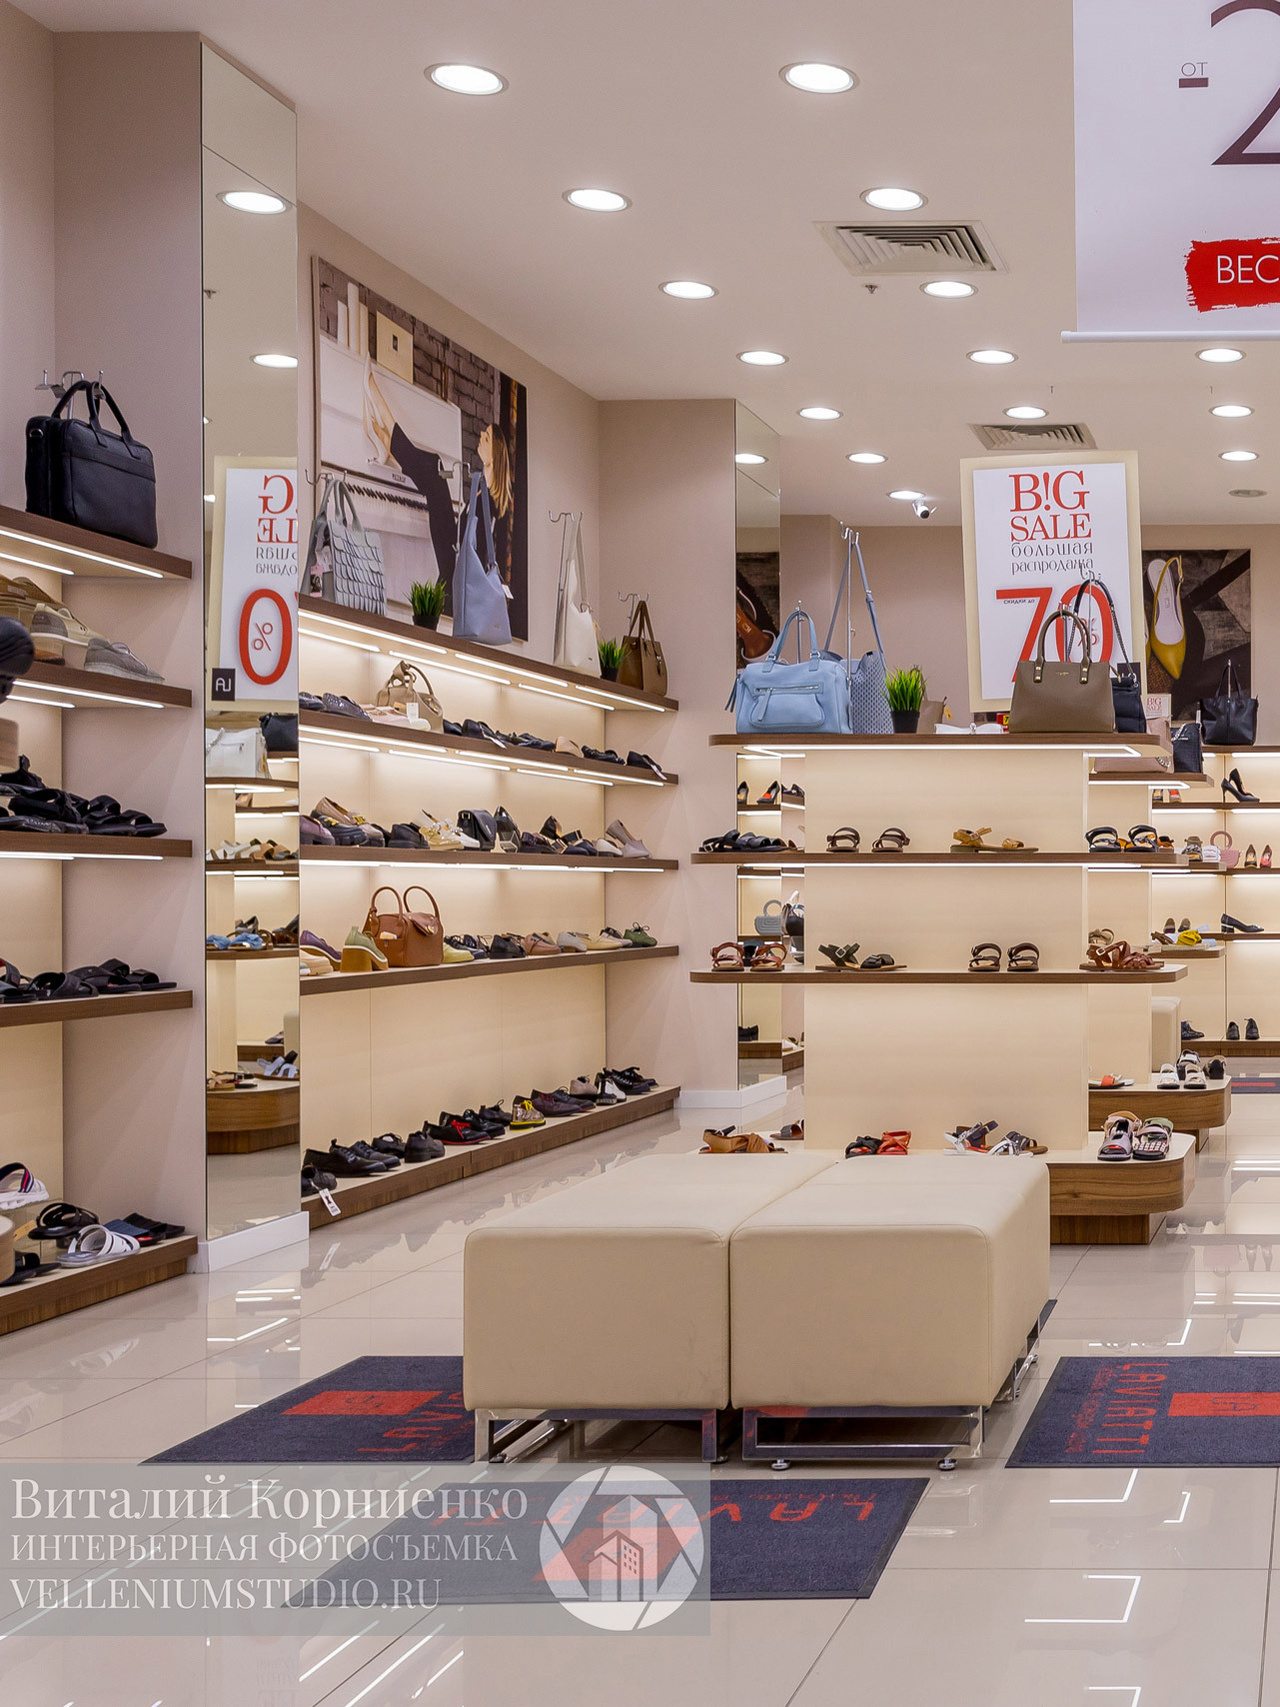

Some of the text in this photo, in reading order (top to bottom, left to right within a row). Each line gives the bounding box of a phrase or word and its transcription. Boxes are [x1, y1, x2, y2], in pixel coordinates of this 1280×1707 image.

[1010, 513, 1091, 542] SALE
[1011, 542, 1093, 557] большая
[1011, 558, 1093, 576] распродажа
[995, 583, 1113, 682] 70
